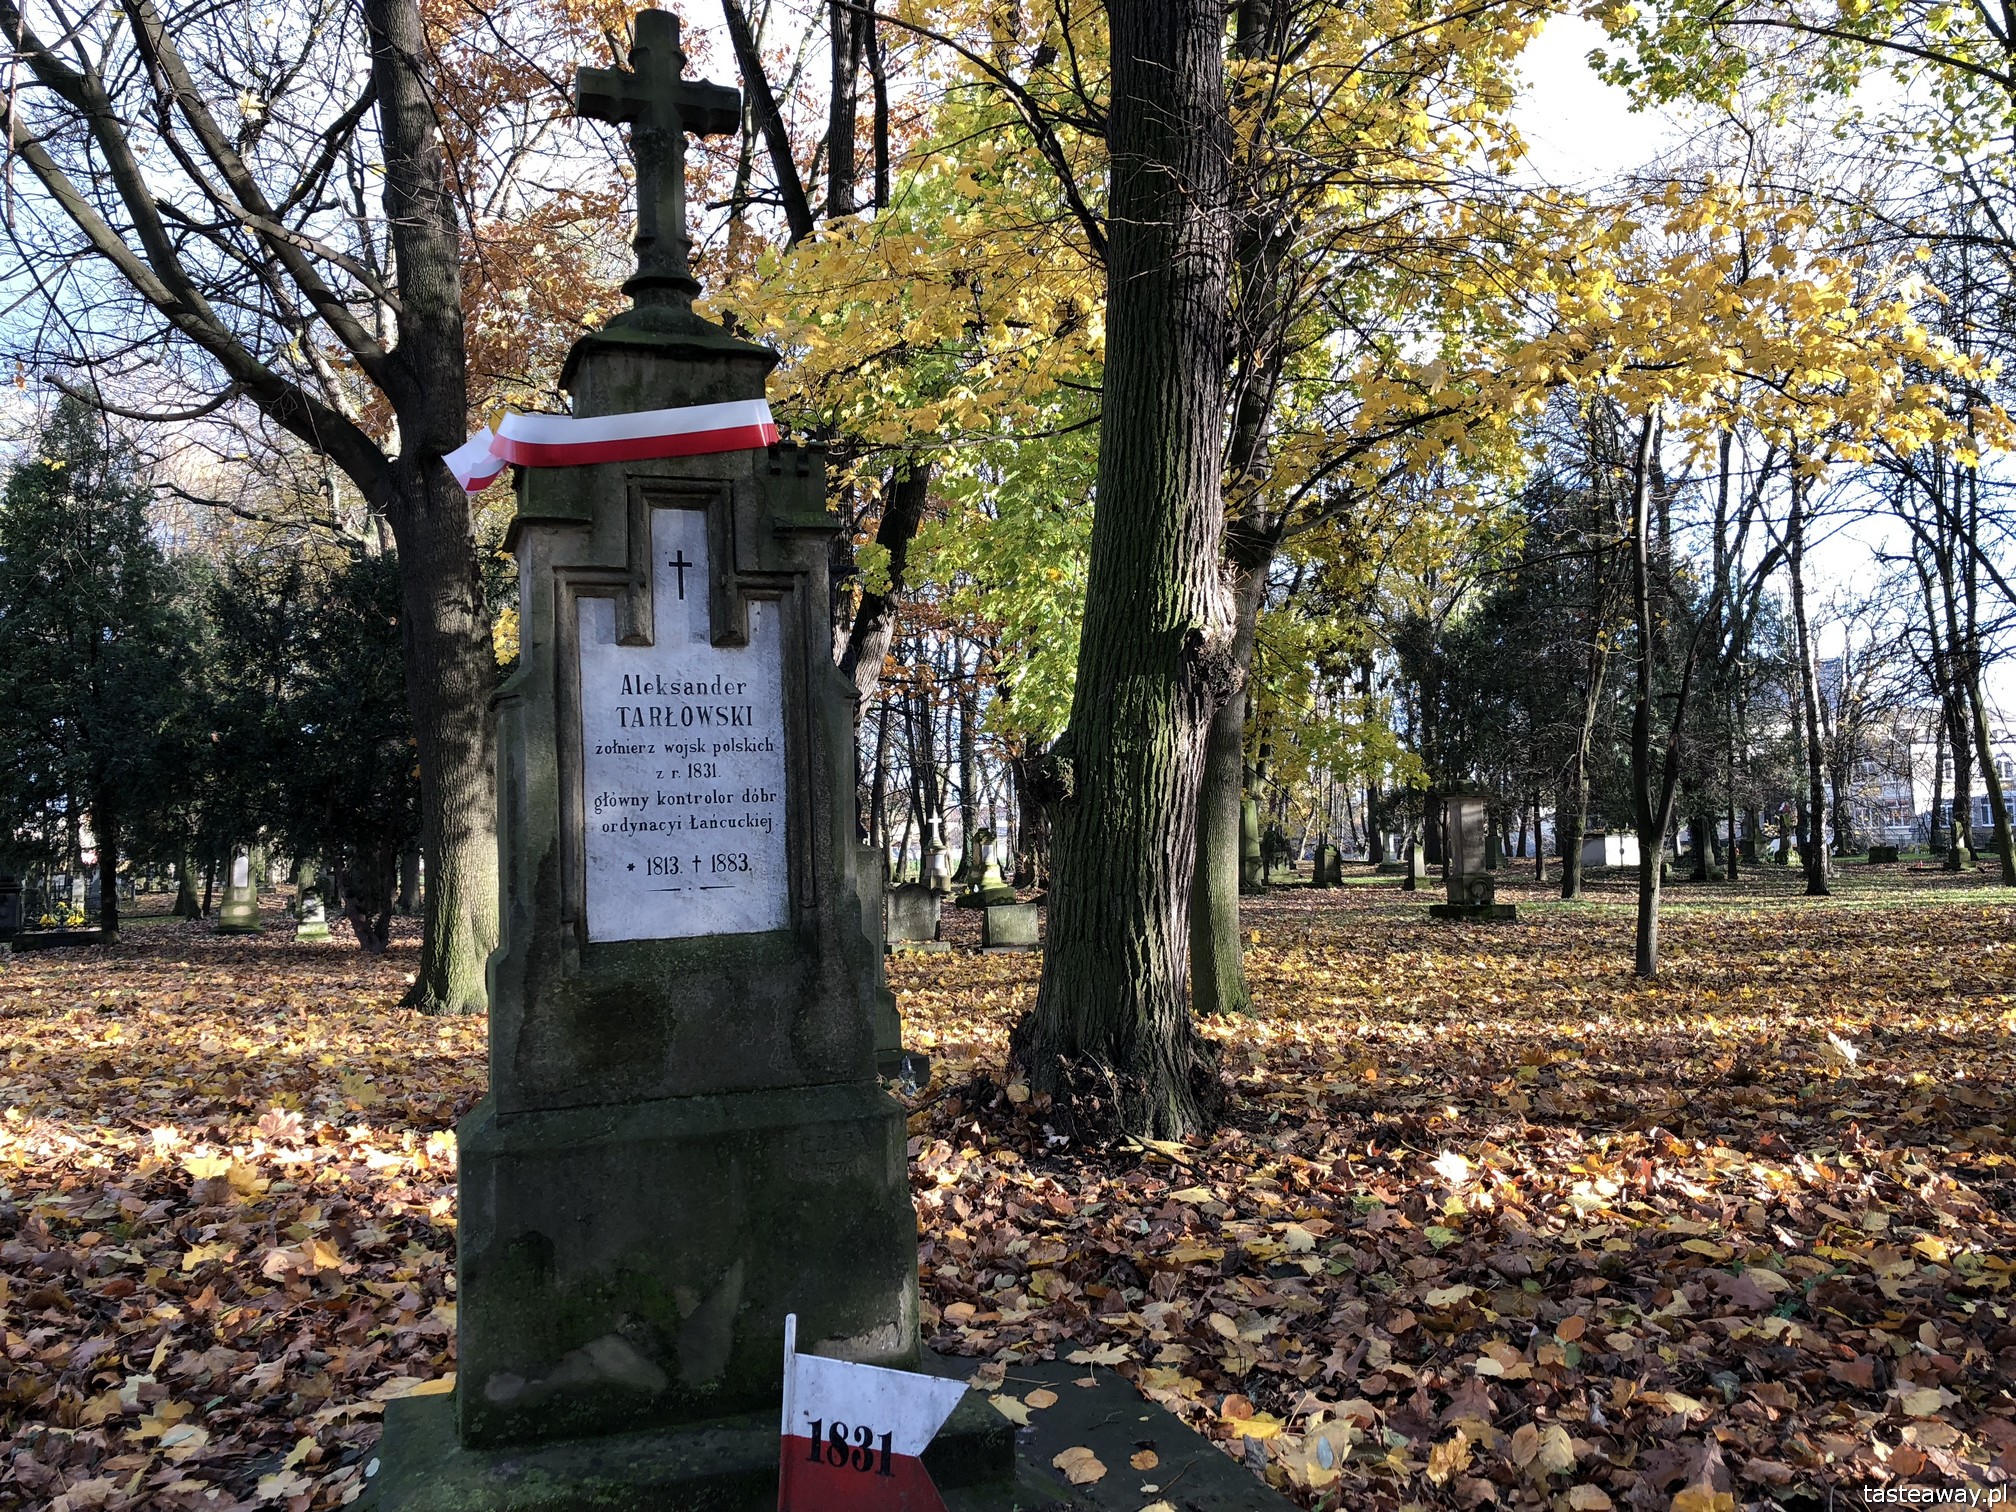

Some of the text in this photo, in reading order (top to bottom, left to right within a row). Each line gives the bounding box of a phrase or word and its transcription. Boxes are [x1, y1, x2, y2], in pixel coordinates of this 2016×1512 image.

[620, 674, 747, 696] Aleksander
[616, 705, 753, 728] TARŁOWSKI
[664, 738, 706, 759] wojsk
[712, 736, 775, 758] polskich
[655, 769, 665, 780] z
[687, 762, 722, 779] 1831.
[594, 787, 778, 815] główny kontrolor dóbr
[601, 815, 682, 838] ordynacyi
[806, 1417, 896, 1478] 1831
